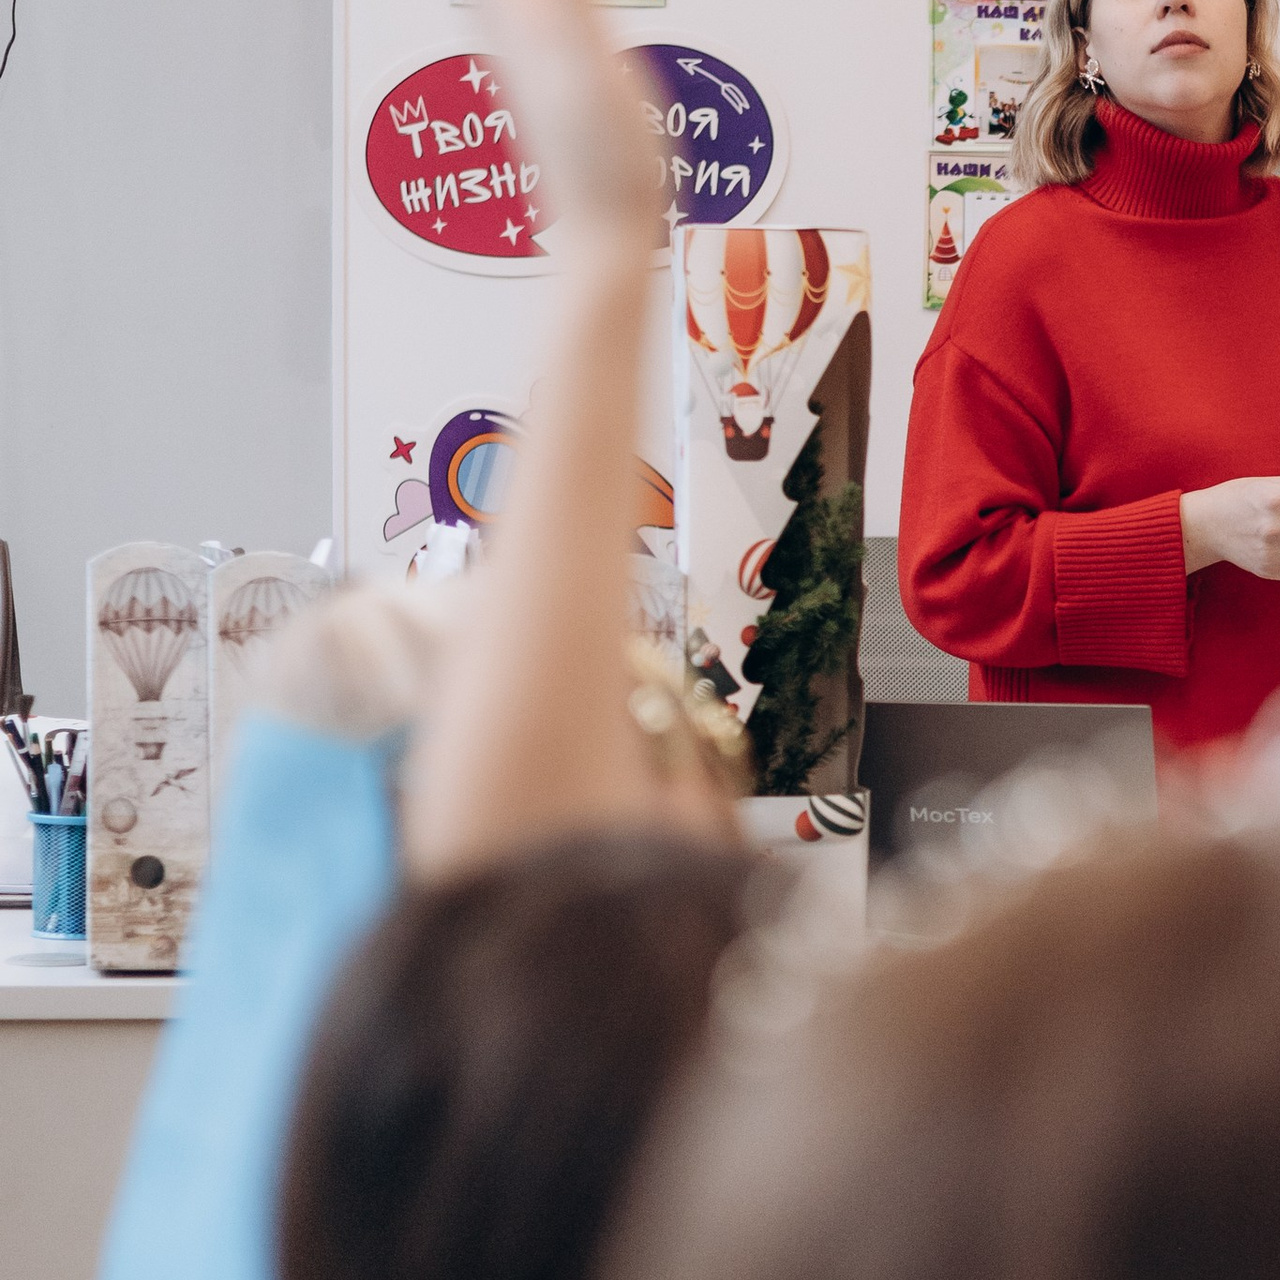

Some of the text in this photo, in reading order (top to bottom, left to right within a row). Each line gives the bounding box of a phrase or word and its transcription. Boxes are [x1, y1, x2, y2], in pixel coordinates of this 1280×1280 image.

[977, 4, 1020, 19] НАШ
[398, 108, 519, 159] ТВОЯ
[638, 100, 720, 141] ВОЯ
[399, 160, 542, 215] ЖИЗНЬ
[936, 161, 992, 179] НАШИ
